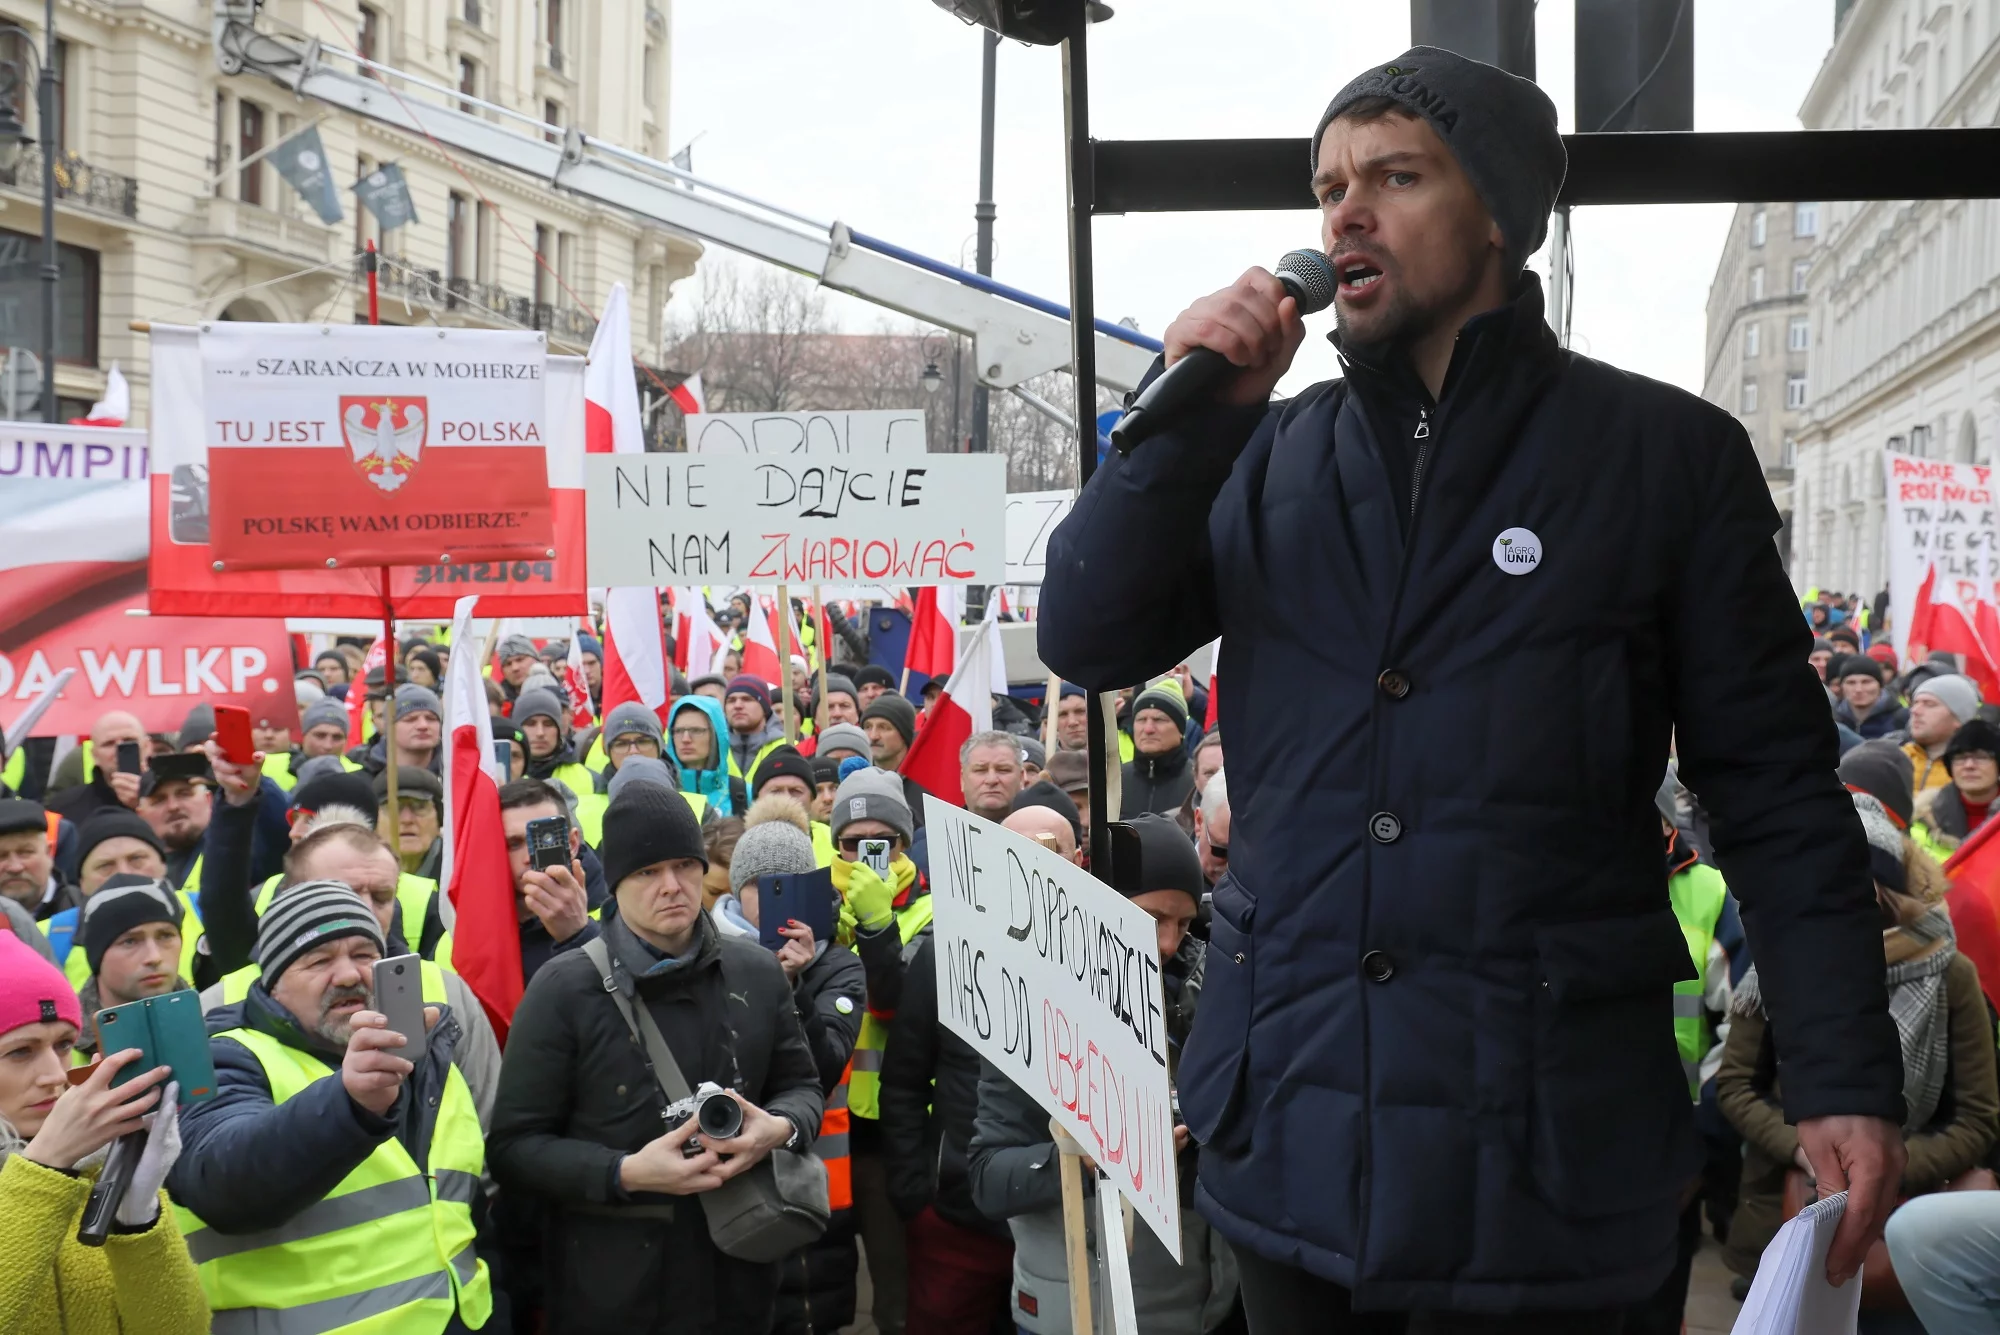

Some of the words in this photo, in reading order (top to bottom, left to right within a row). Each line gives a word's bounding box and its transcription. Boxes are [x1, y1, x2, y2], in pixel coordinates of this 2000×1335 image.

[407, 362, 428, 377] W
[434, 363, 540, 379] MOHERZE
[216, 421, 254, 442] TU
[264, 421, 326, 442] JEST
[442, 421, 541, 442] POLSKA
[0, 441, 149, 480] UMPI
[615, 463, 706, 509] NIE
[754, 464, 927, 518] DAJCIE
[242, 516, 334, 538] POLSKĘ
[340, 514, 400, 533] WAM
[648, 529, 731, 577] NAM
[748, 528, 977, 582] ZWARIOWAĆ
[1507, 546, 1535, 555] AGRO
[1507, 554, 1537, 563] UNIA
[79, 646, 280, 697] WLKP.
[945, 817, 986, 914] NIE
[947, 938, 992, 1041] NAS
[1001, 965, 1032, 1069] DO
